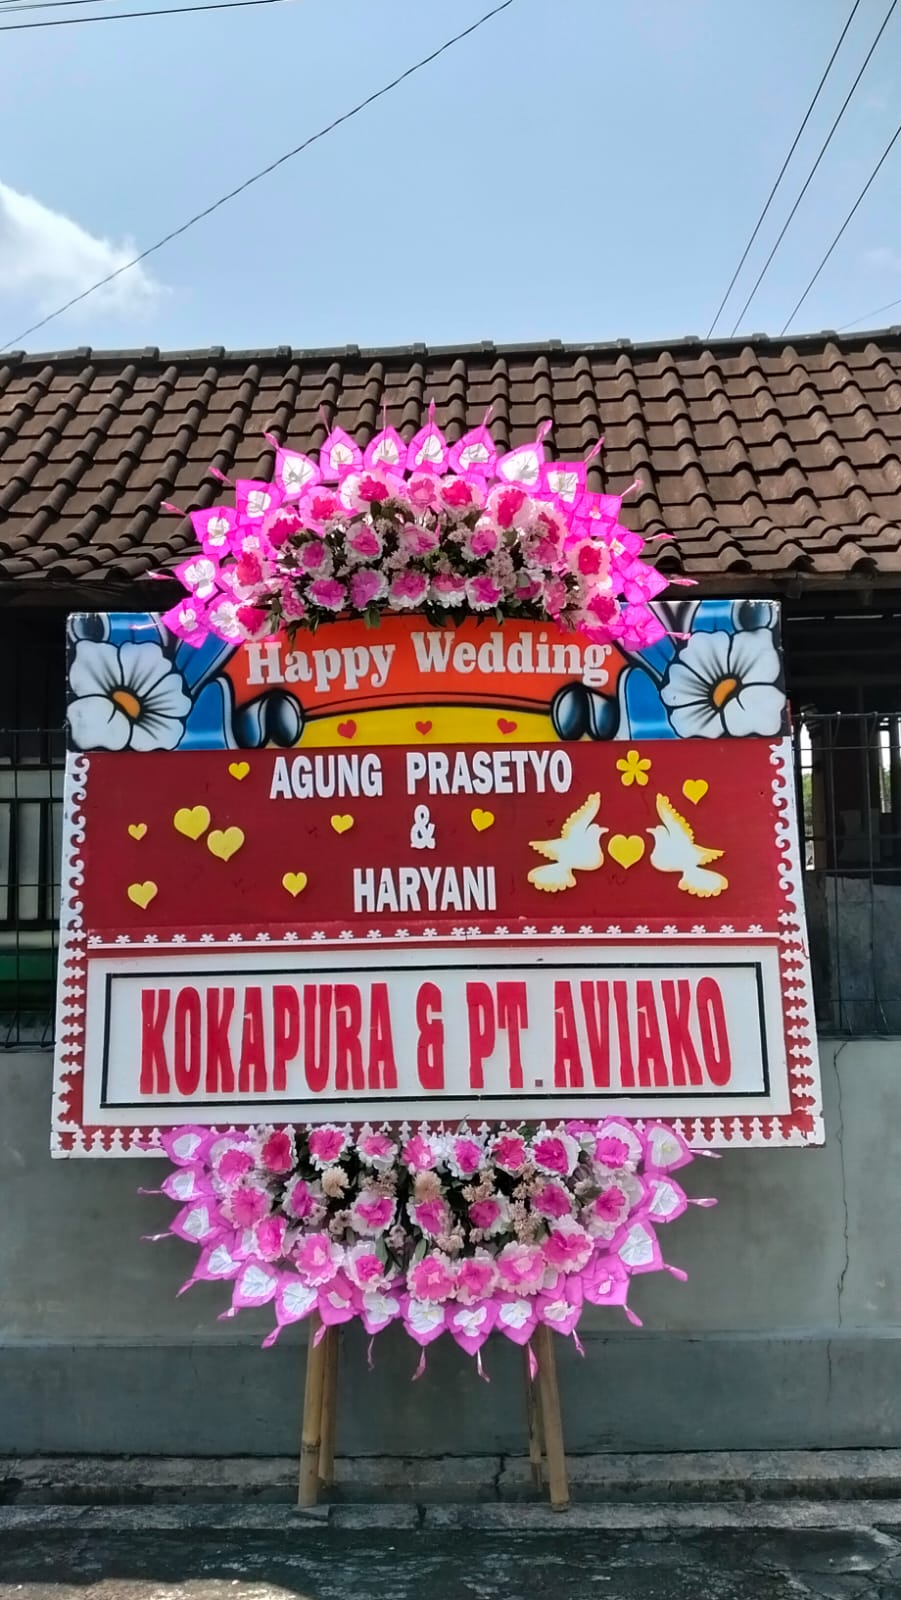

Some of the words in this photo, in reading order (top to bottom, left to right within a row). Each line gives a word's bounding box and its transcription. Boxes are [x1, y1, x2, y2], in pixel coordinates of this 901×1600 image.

[244, 641, 396, 692] Happy
[410, 631, 612, 687] Wedding
[269, 754, 383, 799] AGUNG
[406, 750, 572, 795] PRASETYO
[410, 804, 436, 849] &
[353, 866, 497, 913] HARYANI
[140, 982, 398, 1096] KOKAPURA
[416, 981, 445, 1090] &
[466, 981, 543, 1089] PT.
[554, 976, 732, 1088] AVIAKO
